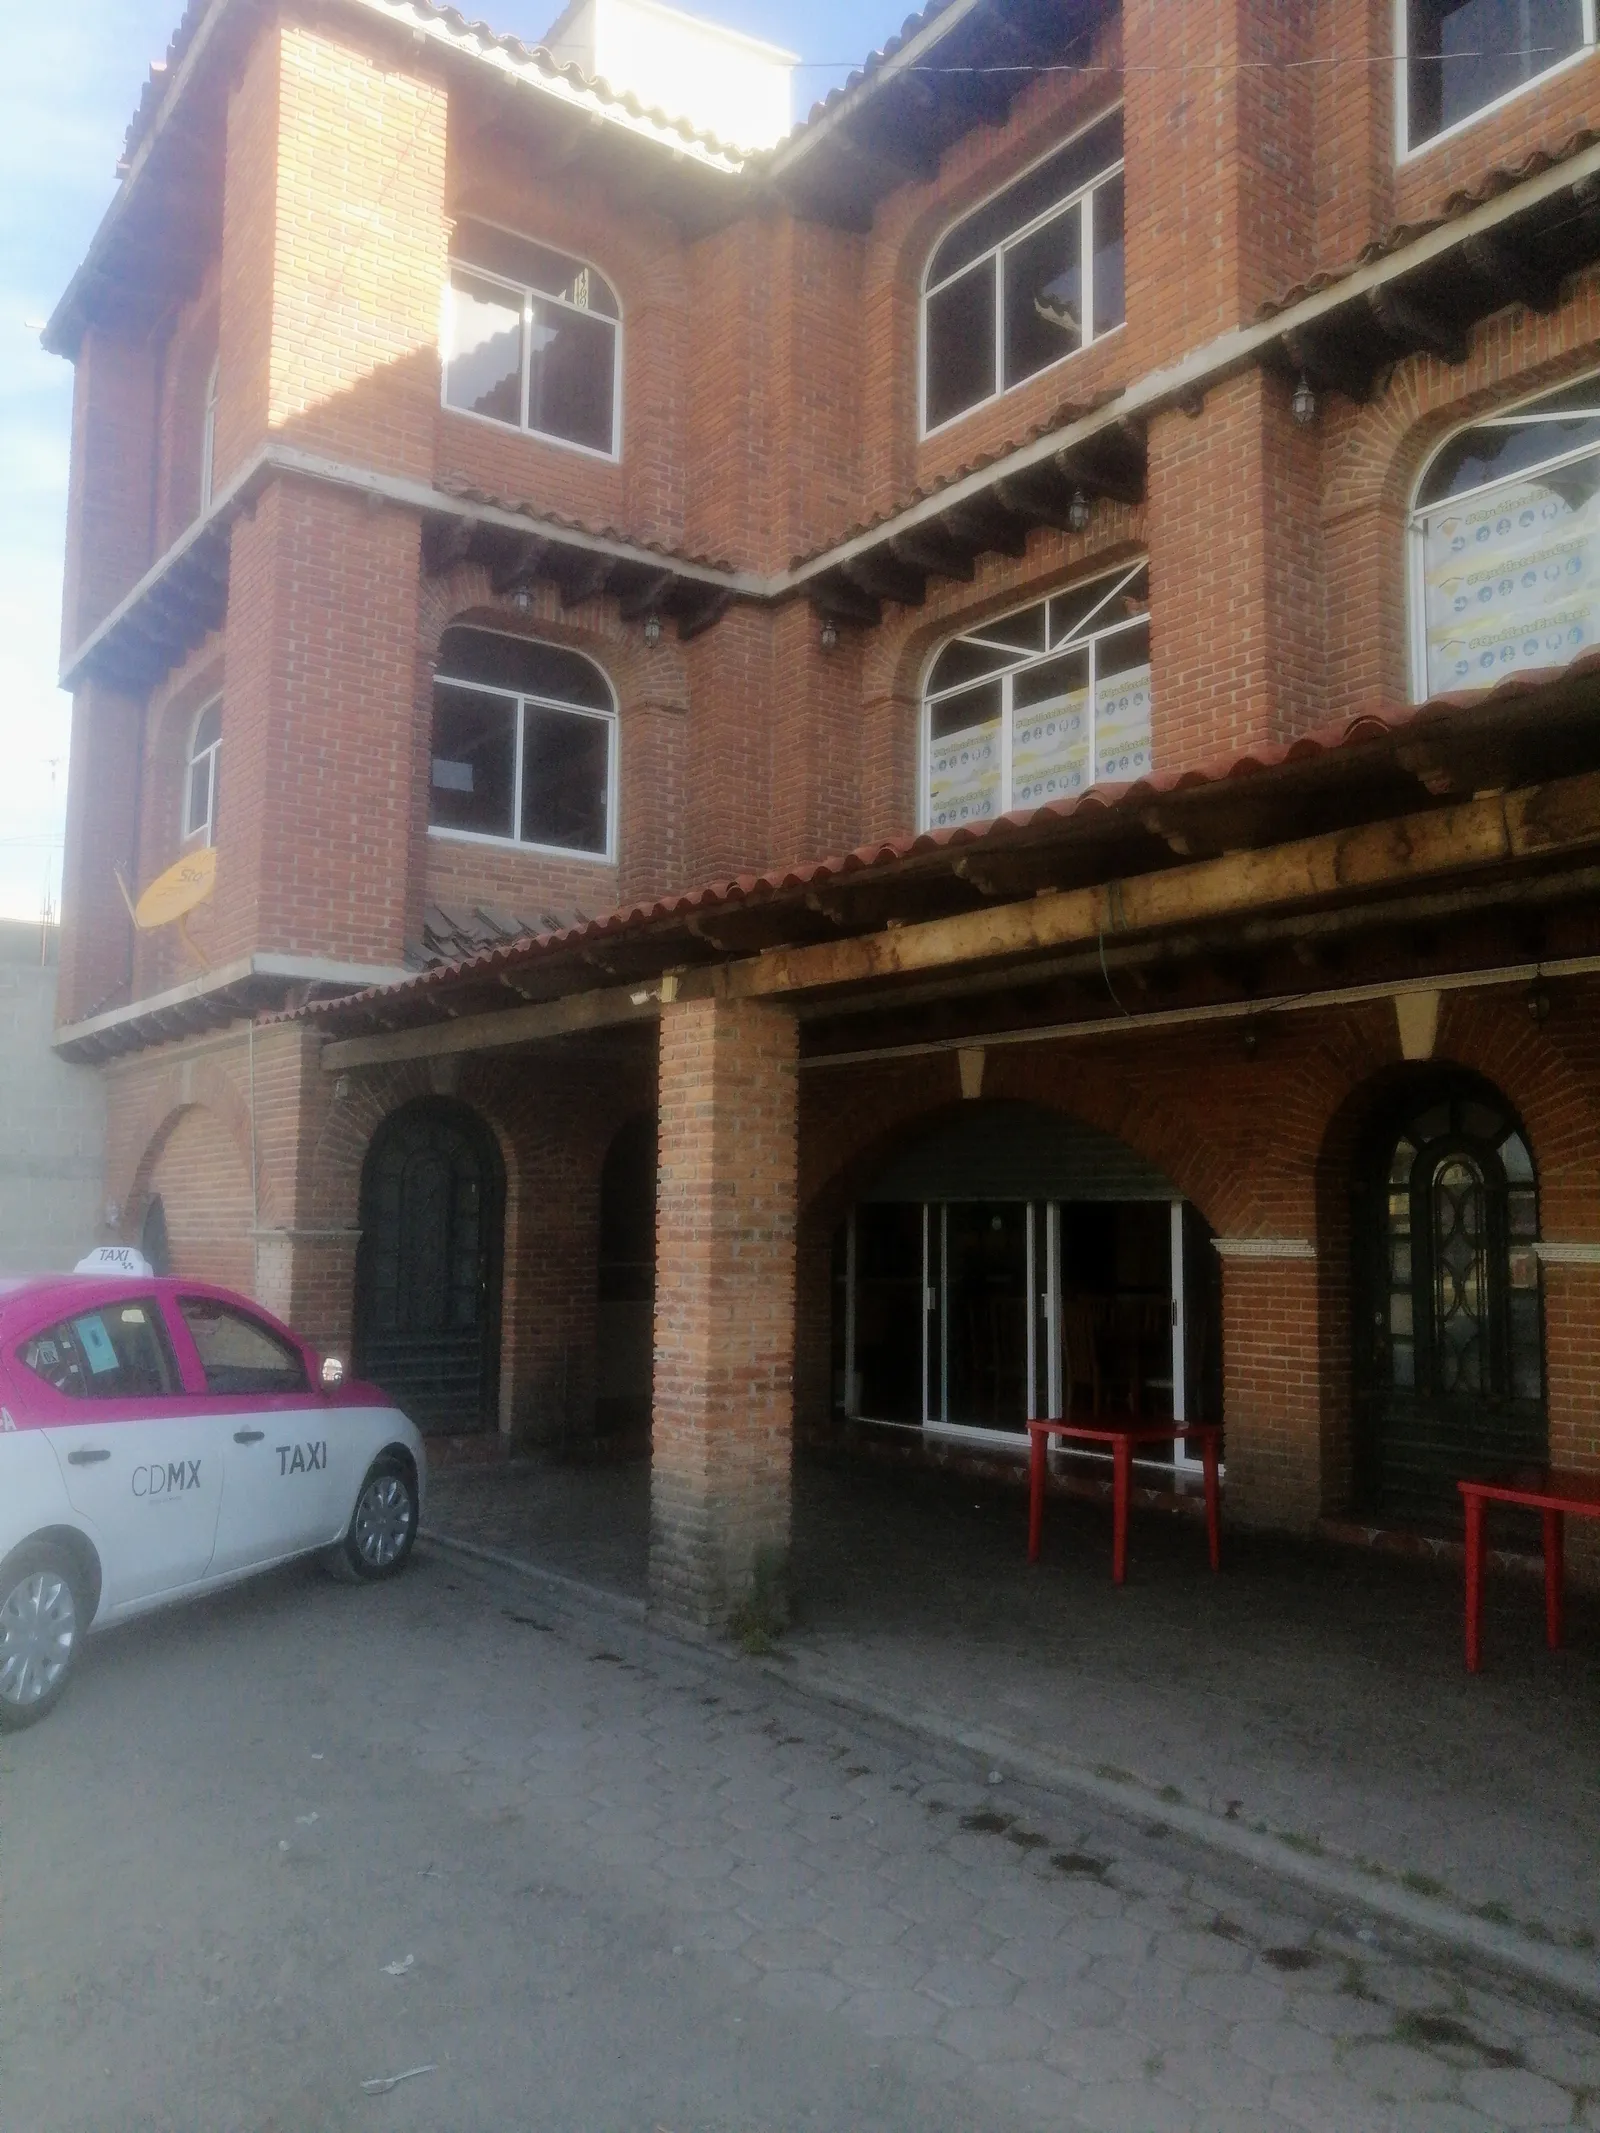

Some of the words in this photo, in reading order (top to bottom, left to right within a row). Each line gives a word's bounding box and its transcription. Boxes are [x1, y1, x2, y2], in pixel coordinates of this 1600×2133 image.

[100, 1249, 129, 1261] TAXI
[276, 1441, 327, 1476] TAXI
[132, 1459, 201, 1497] CDMX
